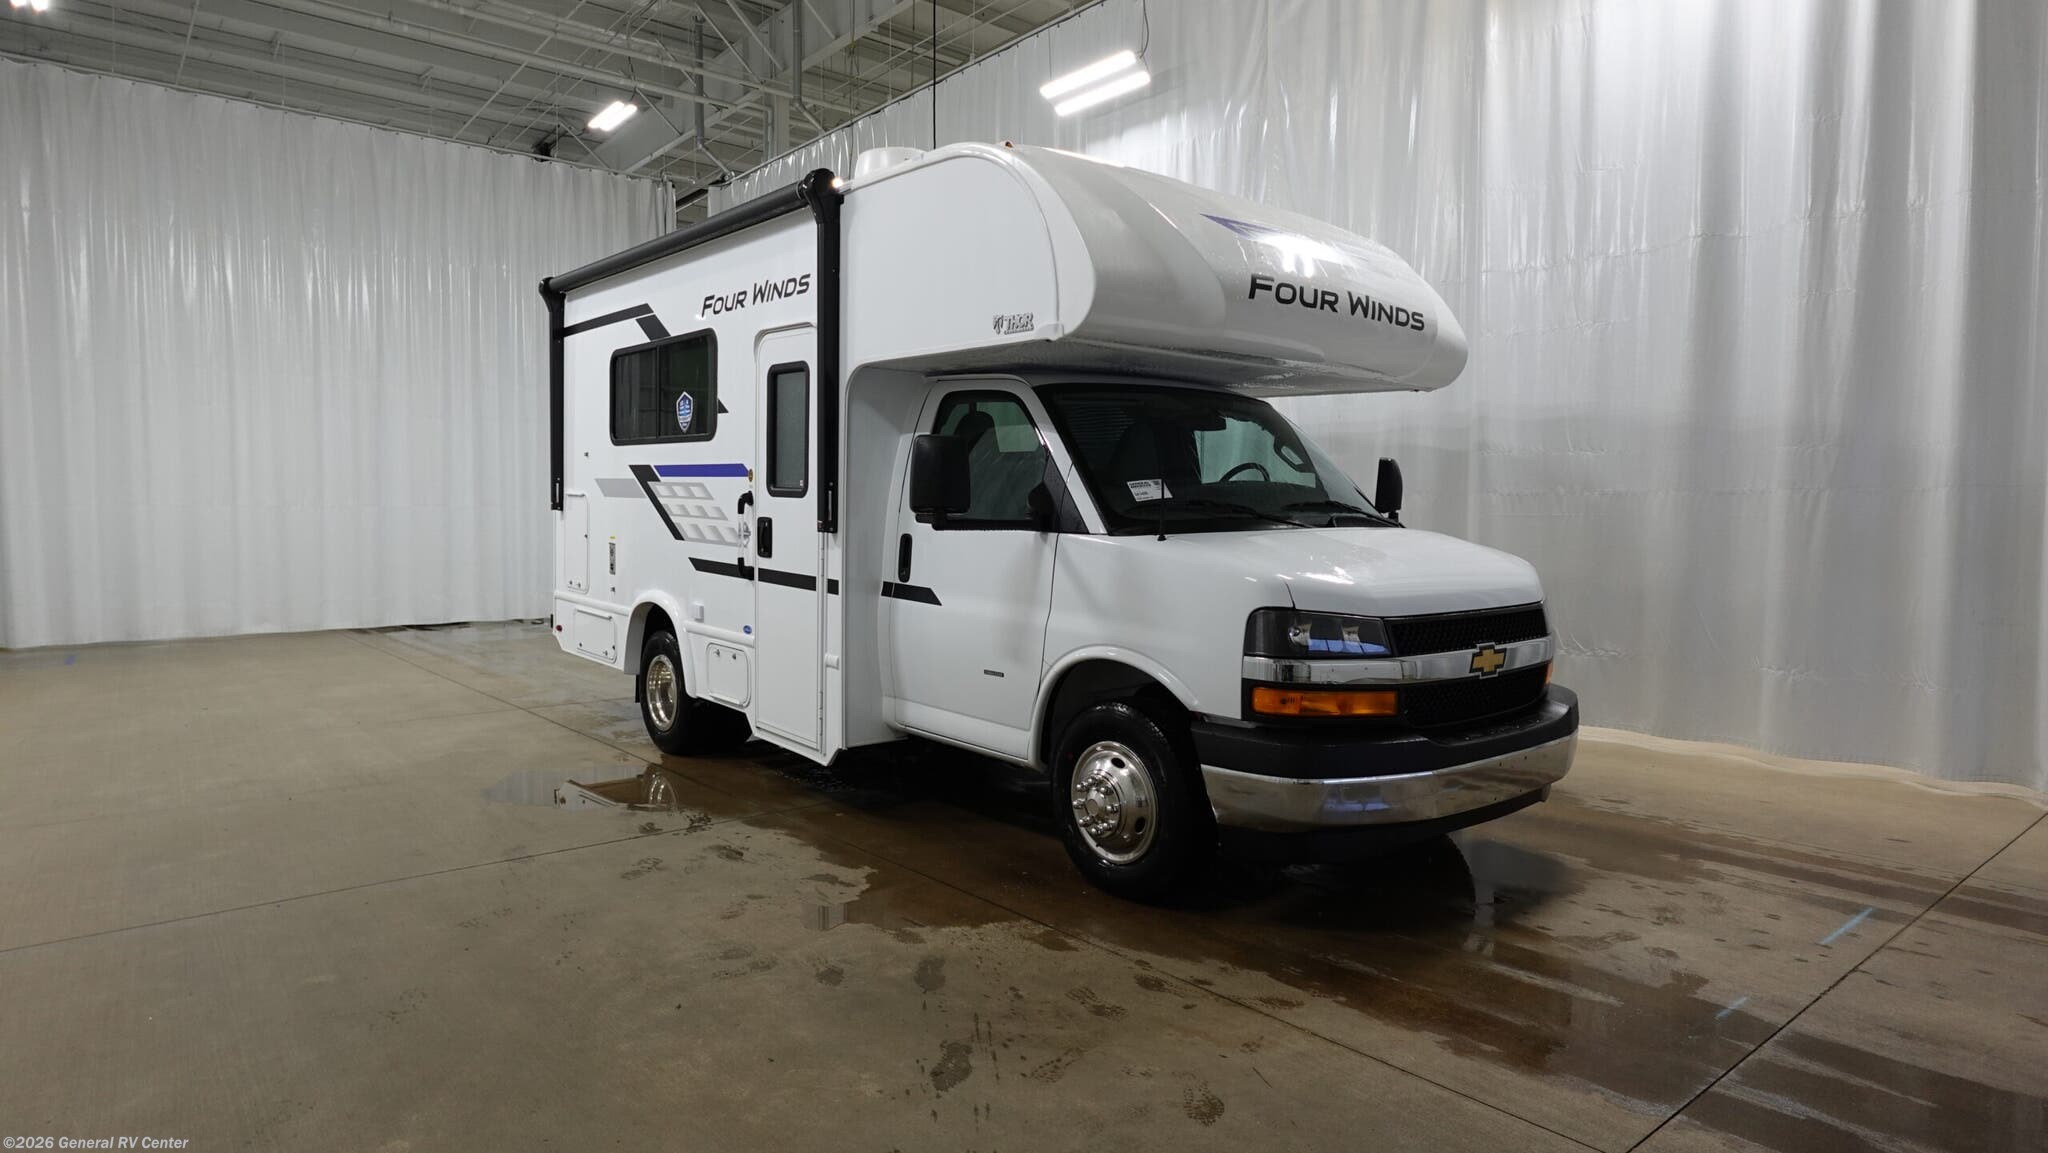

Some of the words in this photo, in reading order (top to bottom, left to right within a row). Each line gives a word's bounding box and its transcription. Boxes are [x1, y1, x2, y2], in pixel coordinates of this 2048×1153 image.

[701, 290, 748, 318] FOUR
[752, 273, 811, 306] WINDS
[1248, 273, 1340, 313] FOUR
[1347, 290, 1426, 332] WINDS
